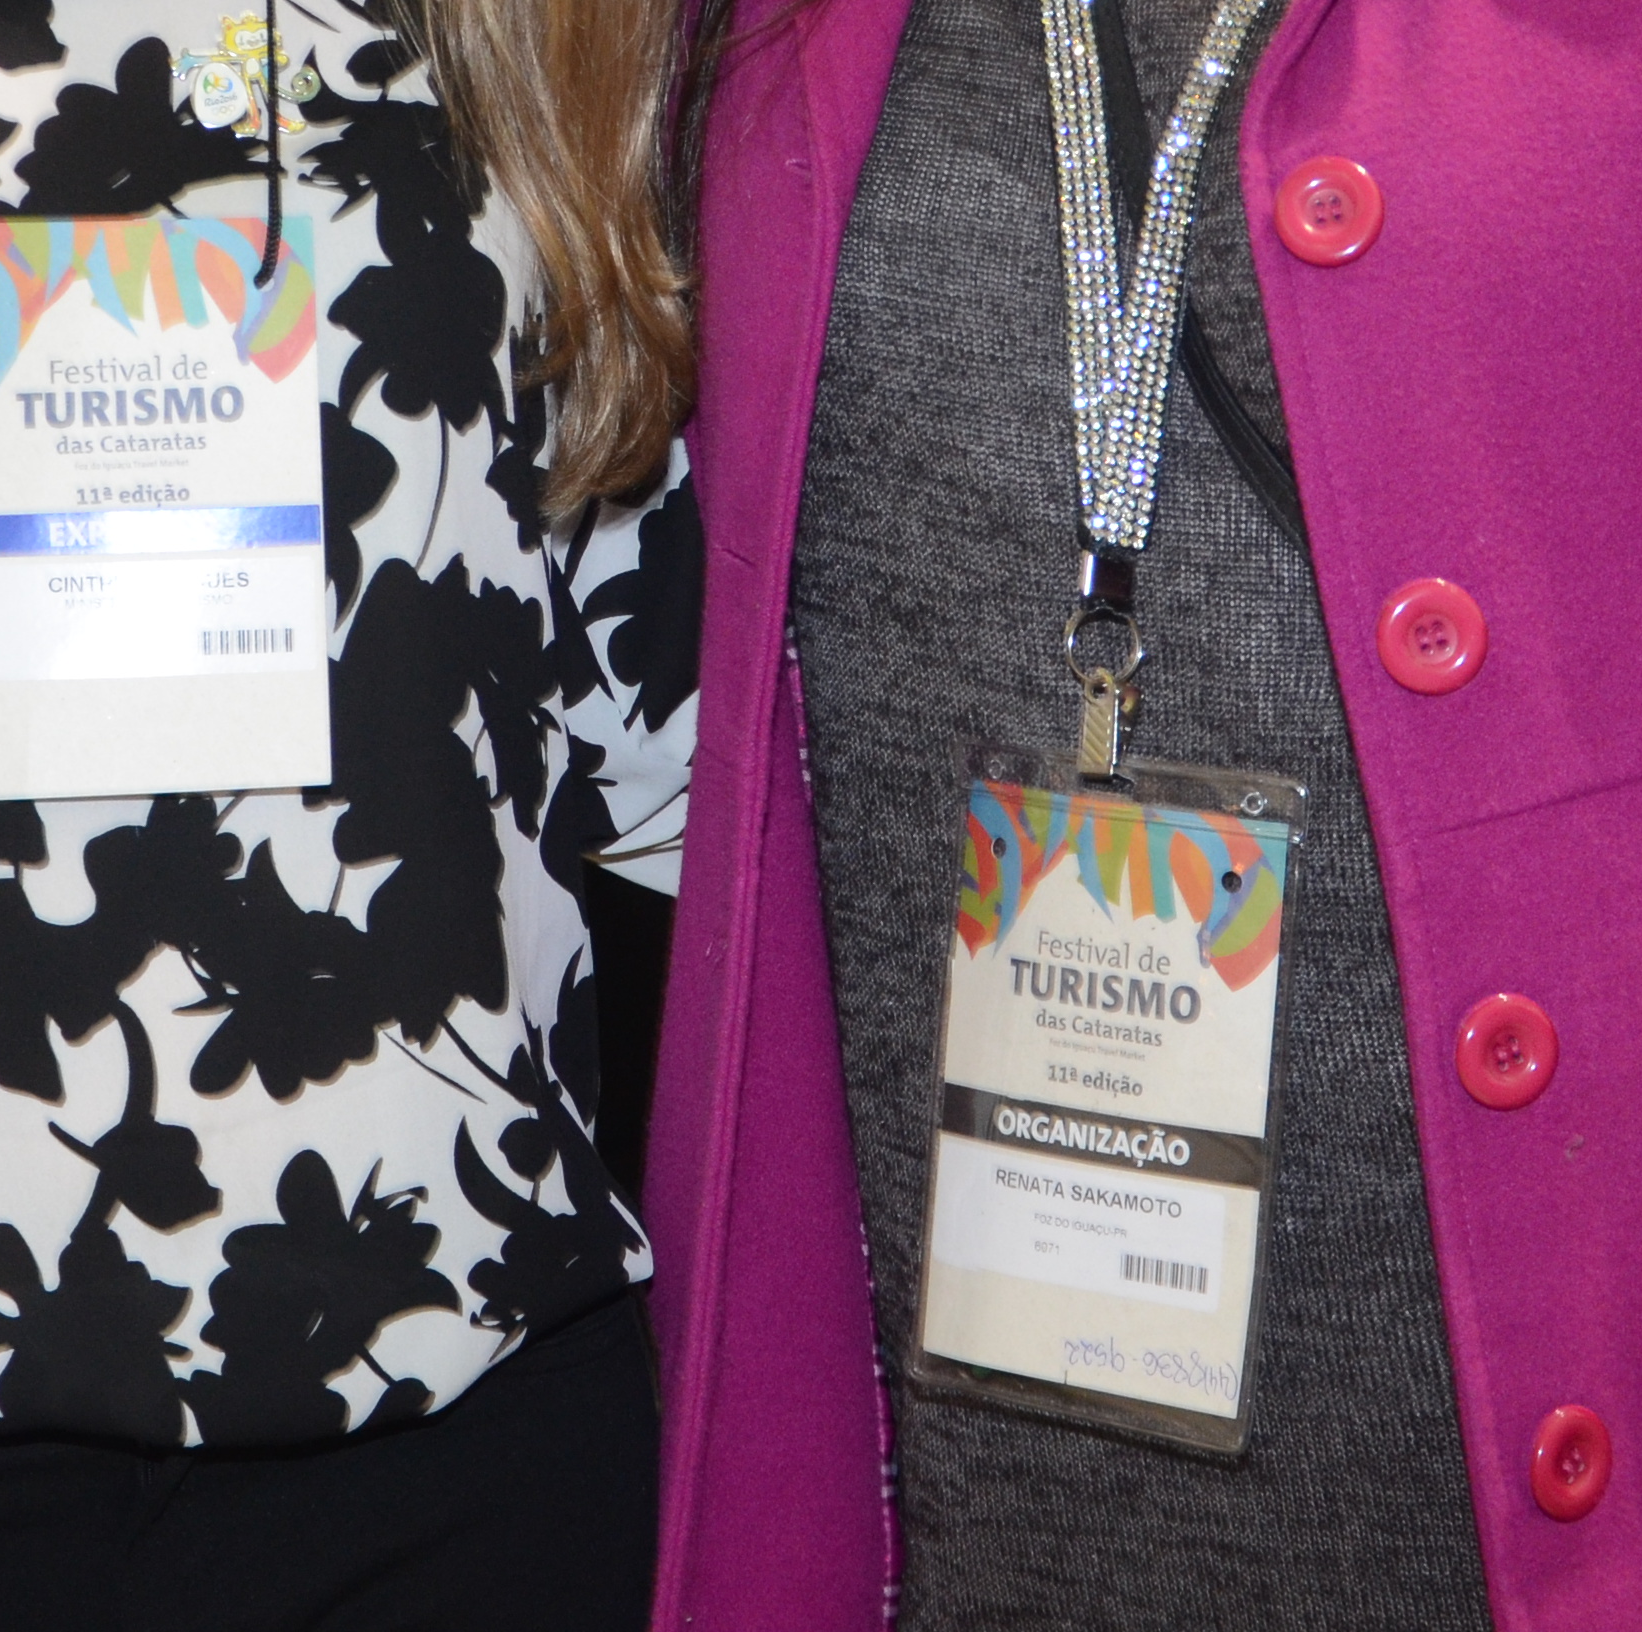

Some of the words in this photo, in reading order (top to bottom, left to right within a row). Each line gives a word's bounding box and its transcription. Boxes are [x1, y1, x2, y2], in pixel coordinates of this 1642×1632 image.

[49, 355, 162, 384] Festival
[172, 354, 208, 381] de
[16, 385, 245, 429] TURISMO
[56, 435, 94, 455] das
[100, 433, 207, 454] Cataratas
[119, 484, 191, 508] edição
[1038, 930, 1131, 970] Festival
[1138, 945, 1171, 976] de
[1010, 958, 1202, 1024] TURISMO
[1036, 1009, 1067, 1031] das
[1072, 1015, 1163, 1047] Cataratas
[1082, 1071, 1144, 1098] edição
[997, 1109, 1191, 1168] ORGANIZAÇÃO
[996, 1168, 1065, 1199] RENATA
[1071, 1184, 1182, 1218] SAKAMOTO
[1034, 1212, 1053, 1226] FOZ
[1054, 1216, 1070, 1229] DO
[1072, 1220, 1128, 1239] IGUAÇU-PR
